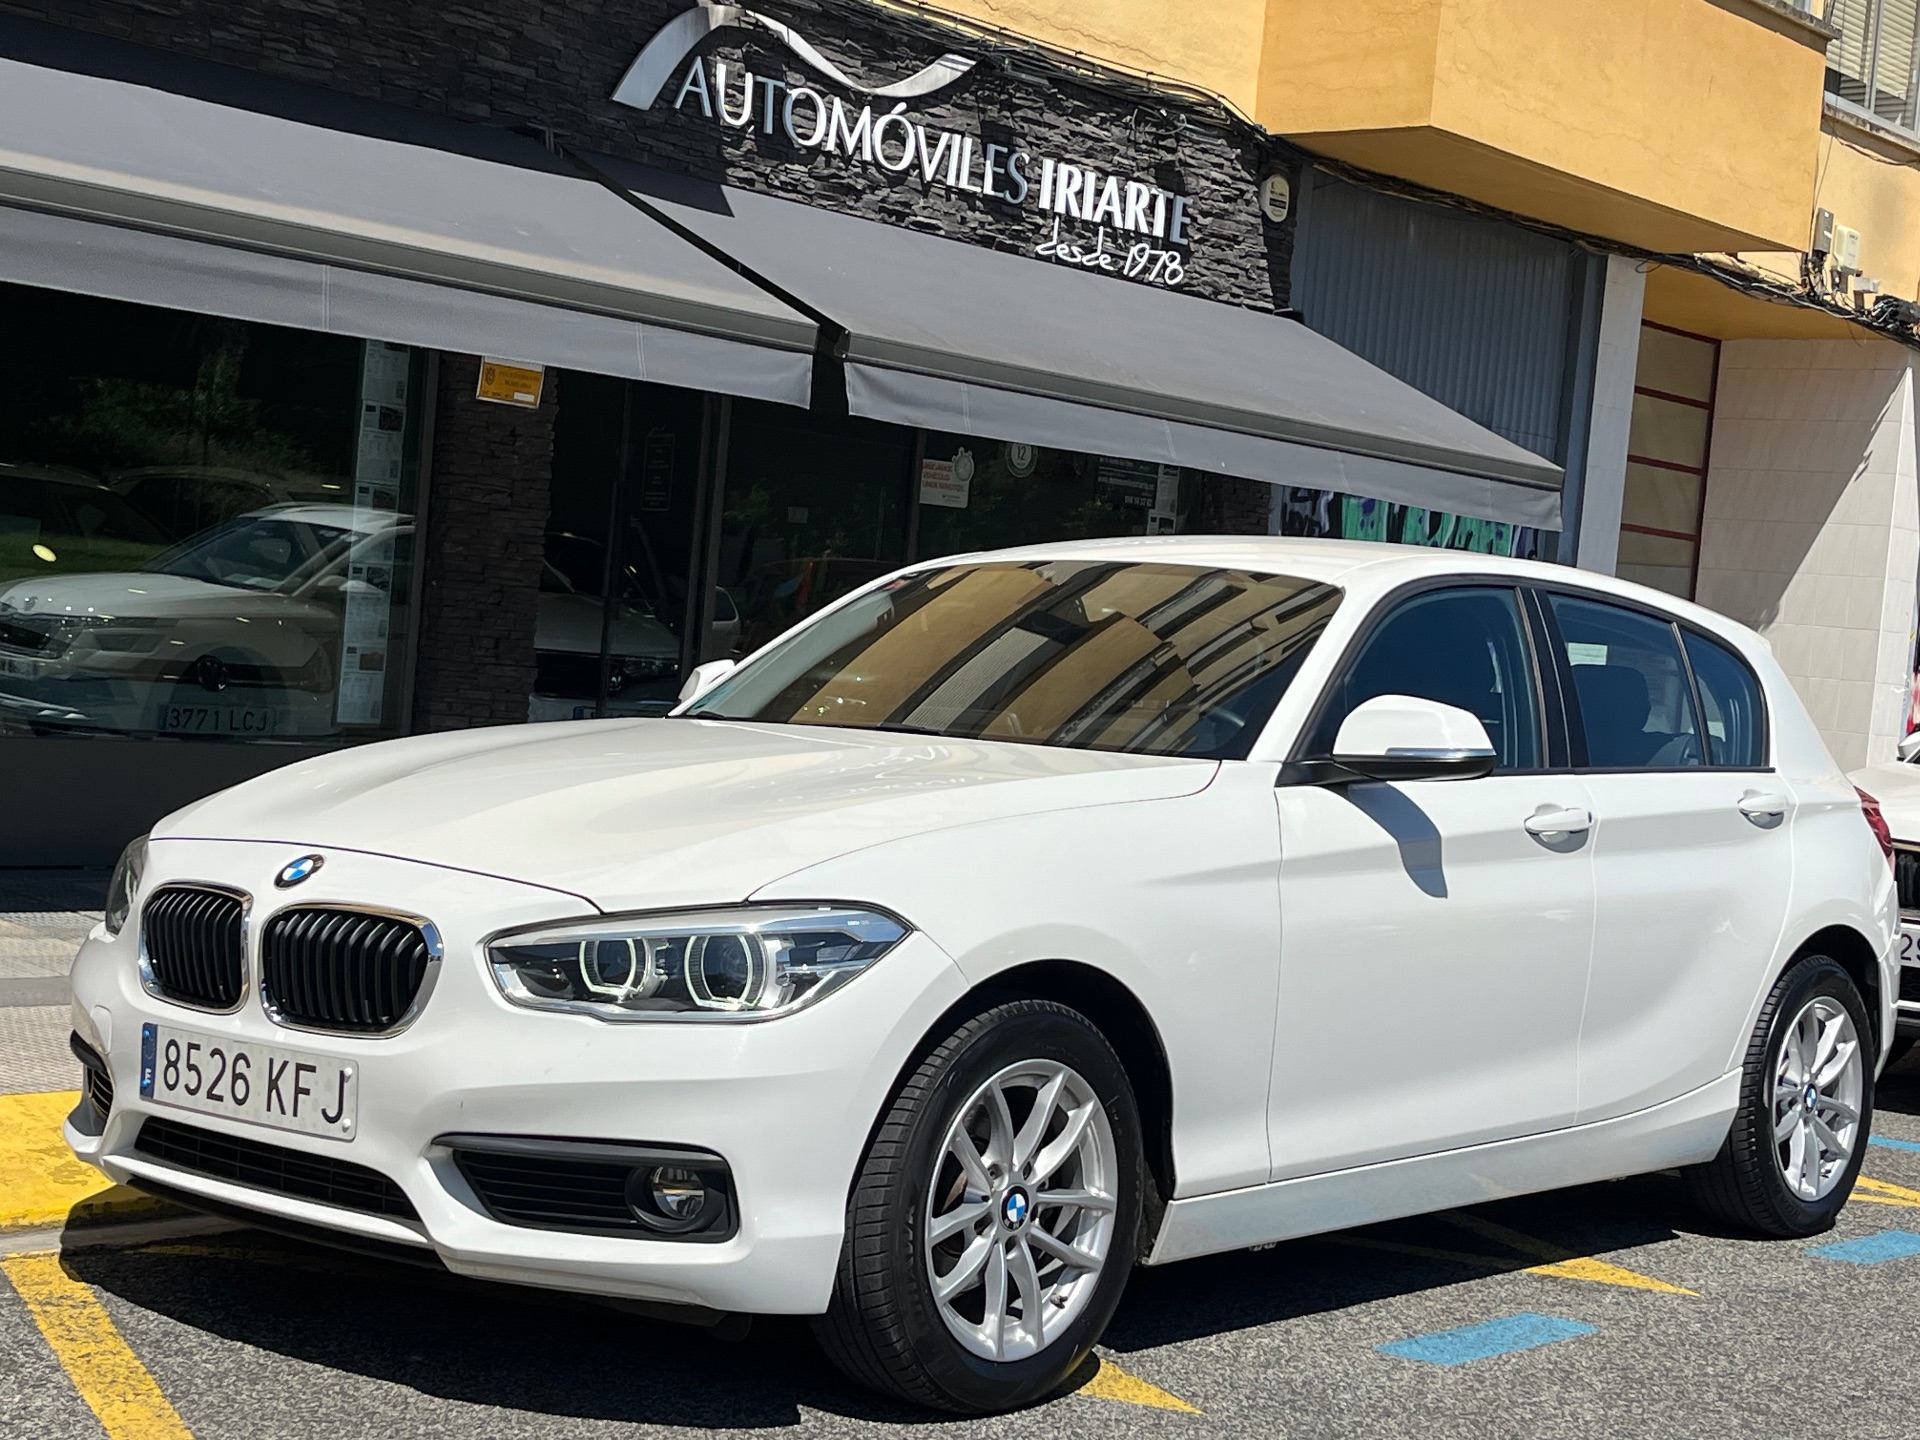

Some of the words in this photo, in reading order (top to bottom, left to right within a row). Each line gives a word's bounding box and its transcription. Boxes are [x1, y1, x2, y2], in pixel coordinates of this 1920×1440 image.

[673, 55, 1030, 204] AUTOMÓVILES
[1038, 159, 1193, 246] IRIARTE
[1035, 215, 1115, 271] desde
[1123, 243, 1185, 285] 1978
[1017, 445, 1027, 461] 12
[168, 707, 220, 730] 3771
[229, 709, 267, 732] LCJ
[163, 1039, 251, 1106] 8526
[266, 1057, 345, 1124] KFJ
